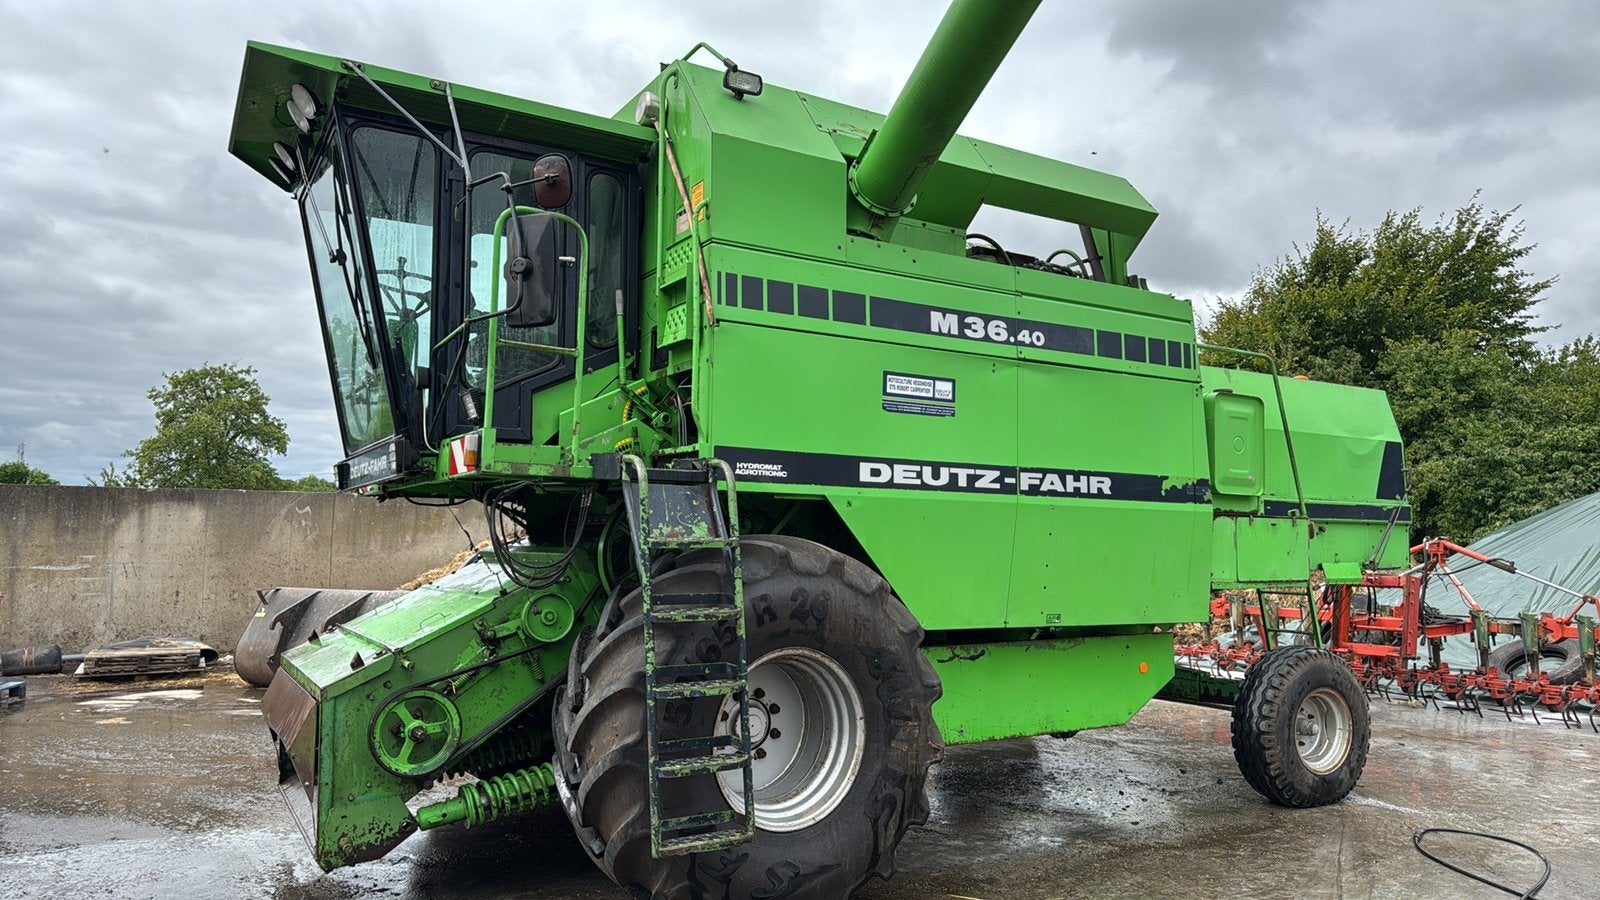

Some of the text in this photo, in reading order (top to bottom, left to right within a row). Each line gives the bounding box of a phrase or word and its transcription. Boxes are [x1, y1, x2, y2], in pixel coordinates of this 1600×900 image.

[929, 310, 1046, 347] M 36.40
[349, 454, 388, 480] DEUTZ-FAHR
[735, 468, 788, 478] AGROTRONIC
[736, 462, 783, 471] HYDROMAT
[858, 460, 1113, 496] DEUTZ-FAHR
